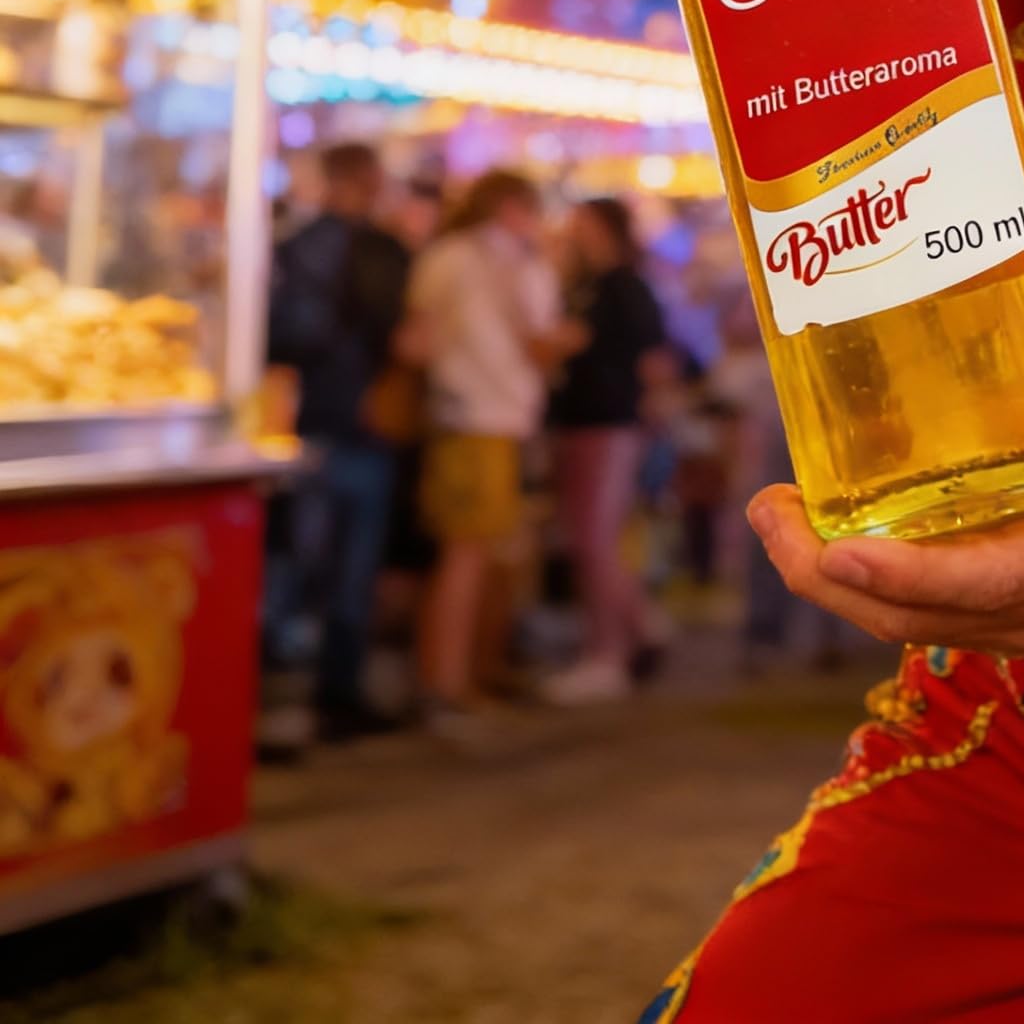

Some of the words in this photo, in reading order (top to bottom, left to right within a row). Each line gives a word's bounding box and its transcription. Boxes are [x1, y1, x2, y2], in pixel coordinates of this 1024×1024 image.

[746, 85, 788, 118] mit
[794, 46, 958, 105] Butteraroma
[766, 167, 931, 286] Butter
[925, 220, 983, 260] 500
